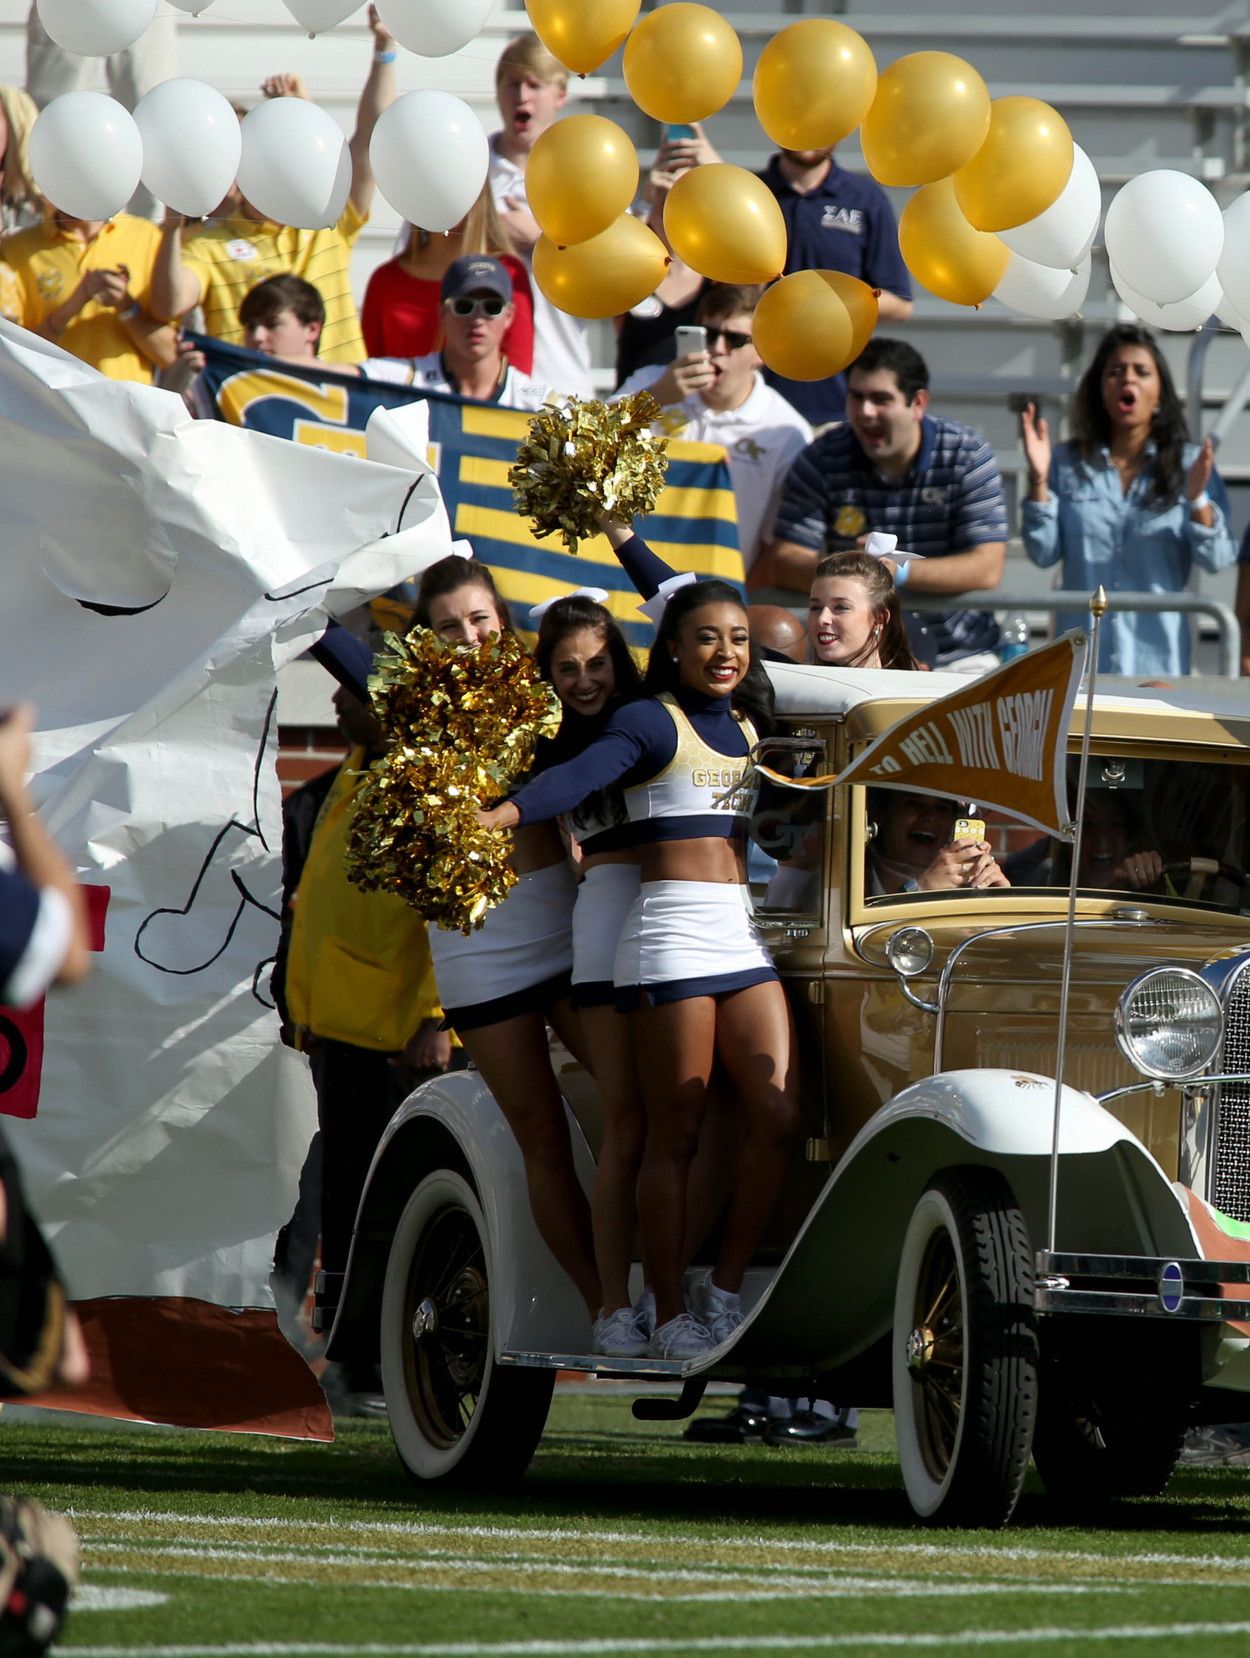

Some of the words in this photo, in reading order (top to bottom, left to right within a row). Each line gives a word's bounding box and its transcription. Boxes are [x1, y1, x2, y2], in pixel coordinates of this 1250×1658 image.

[869, 755, 902, 775] TO
[898, 721, 954, 767] HELL
[946, 701, 1001, 770] WITH
